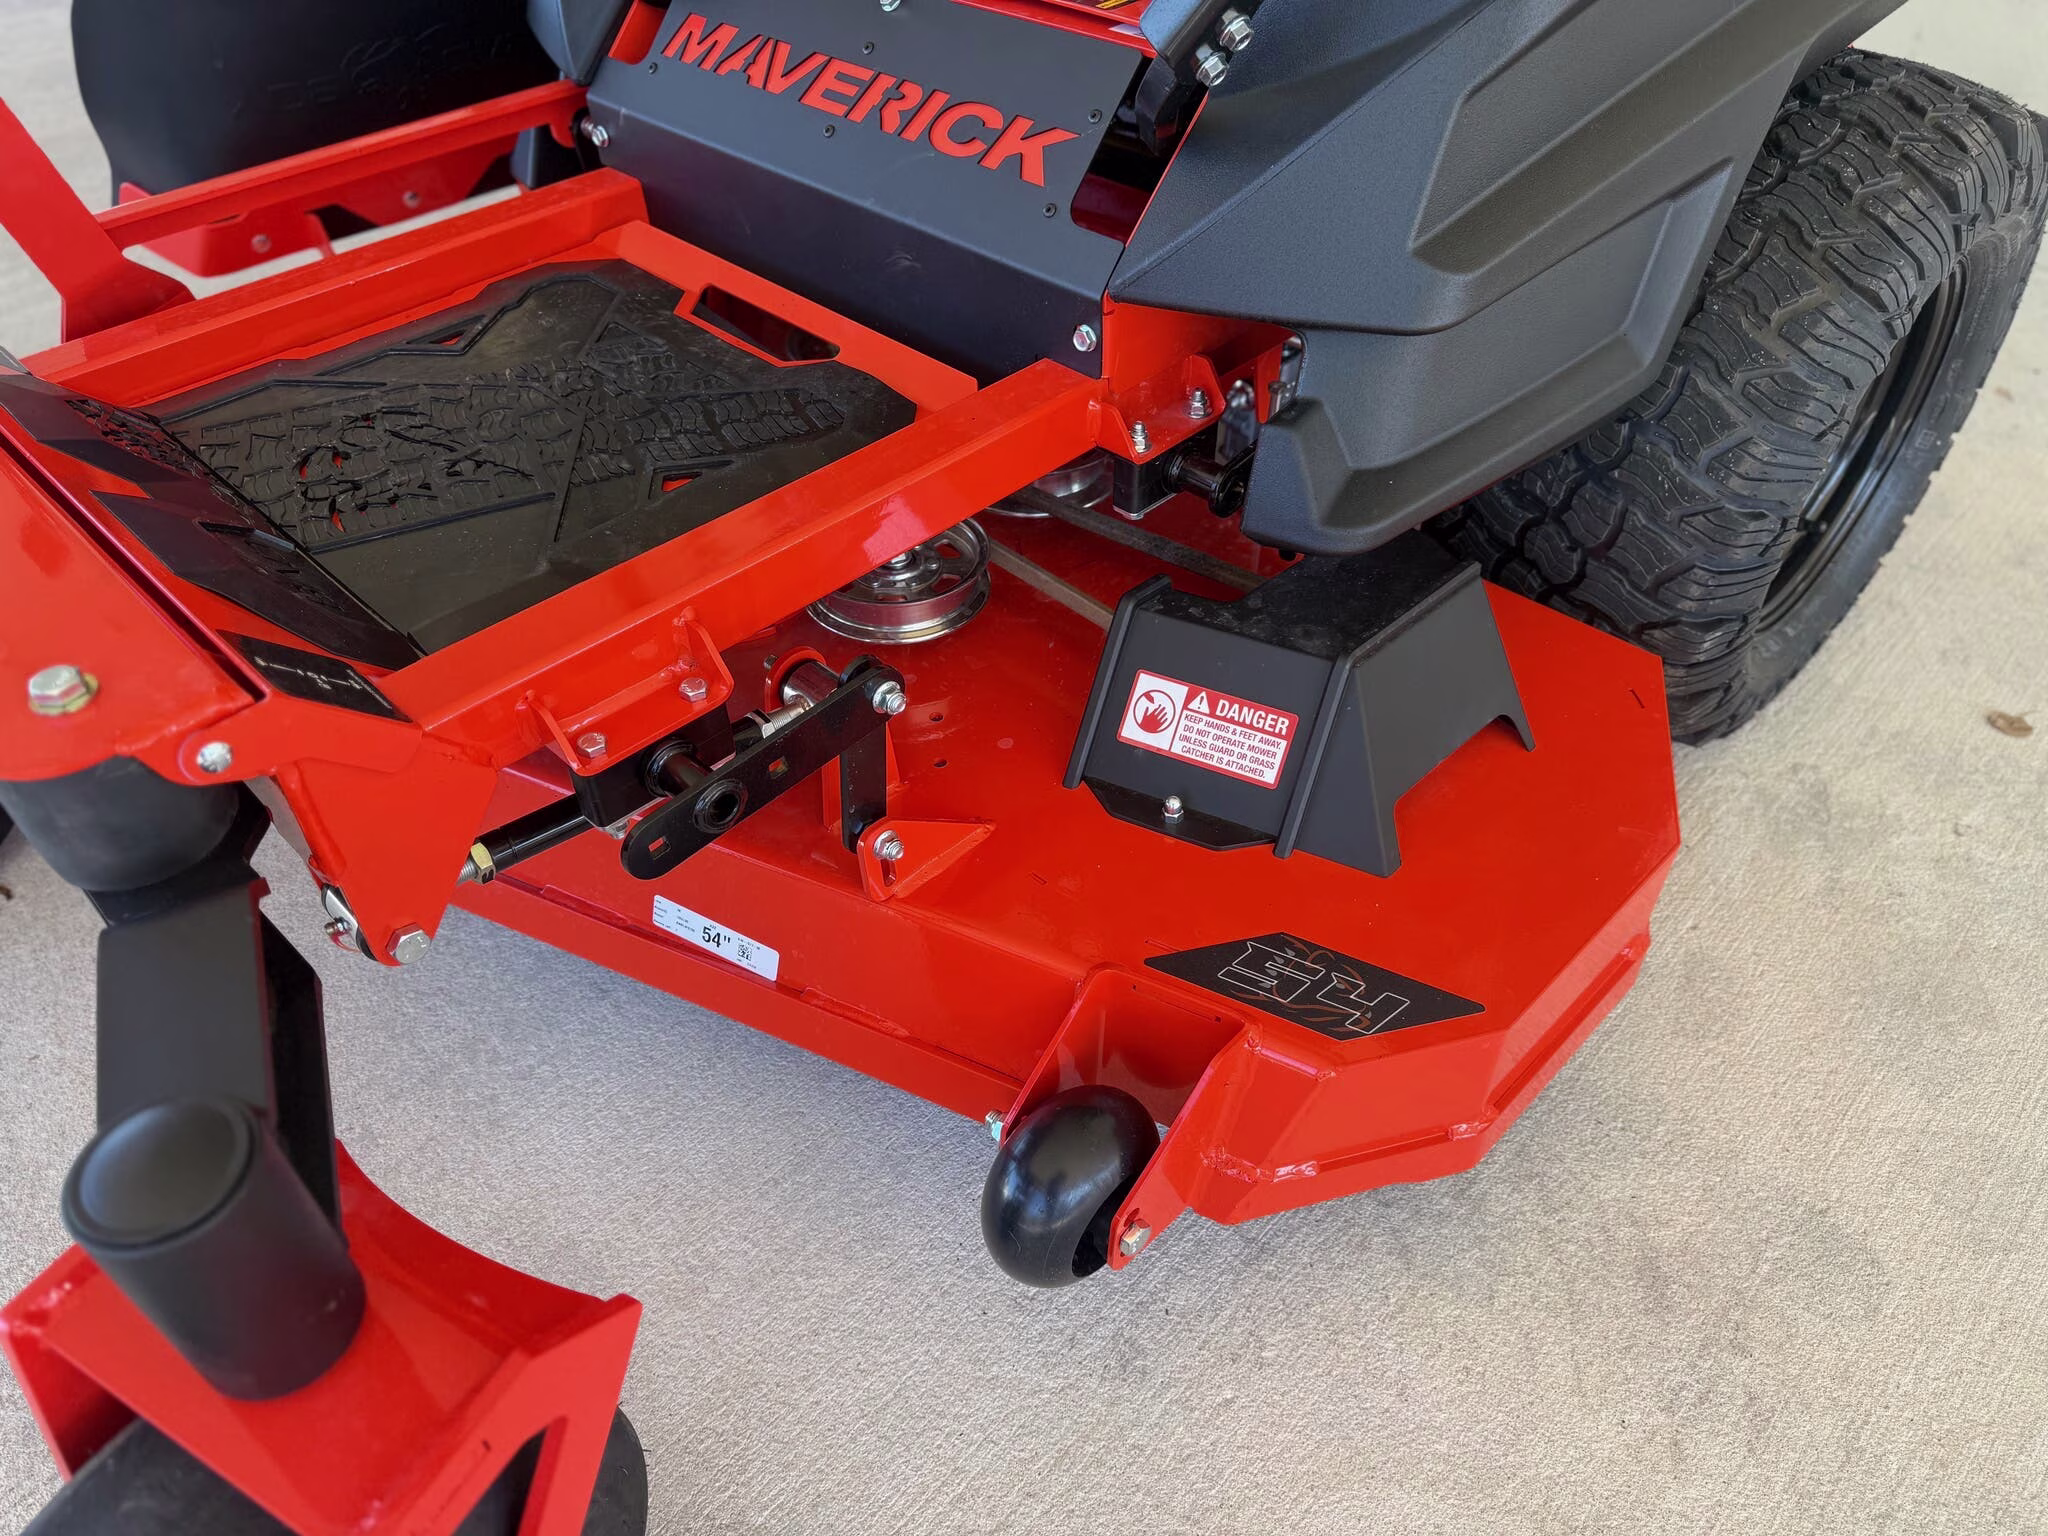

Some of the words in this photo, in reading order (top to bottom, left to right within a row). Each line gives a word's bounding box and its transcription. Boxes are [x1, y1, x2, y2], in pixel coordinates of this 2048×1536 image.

[662, 14, 1081, 187] MAVERICK
[1184, 713, 1203, 725] KEEP
[1204, 720, 1230, 734] HANDS
[1231, 727, 1237, 735] &
[1239, 730, 1258, 741] FEET
[1258, 736, 1281, 750] AWAY.
[1216, 700, 1289, 735] DANGER
[1179, 735, 1207, 749] UNLESS
[1209, 743, 1235, 757] GUARD
[1237, 751, 1248, 760] OR
[1249, 755, 1275, 770] GRASS
[1184, 724, 1193, 733] DO
[1195, 727, 1210, 739] NOT
[1212, 732, 1246, 750] OPERATE
[1247, 743, 1277, 759] MOWER
[1181, 745, 1214, 764] CATCHER
[1225, 759, 1265, 778] ATTACHED.
[1217, 941, 1410, 1035] 54
